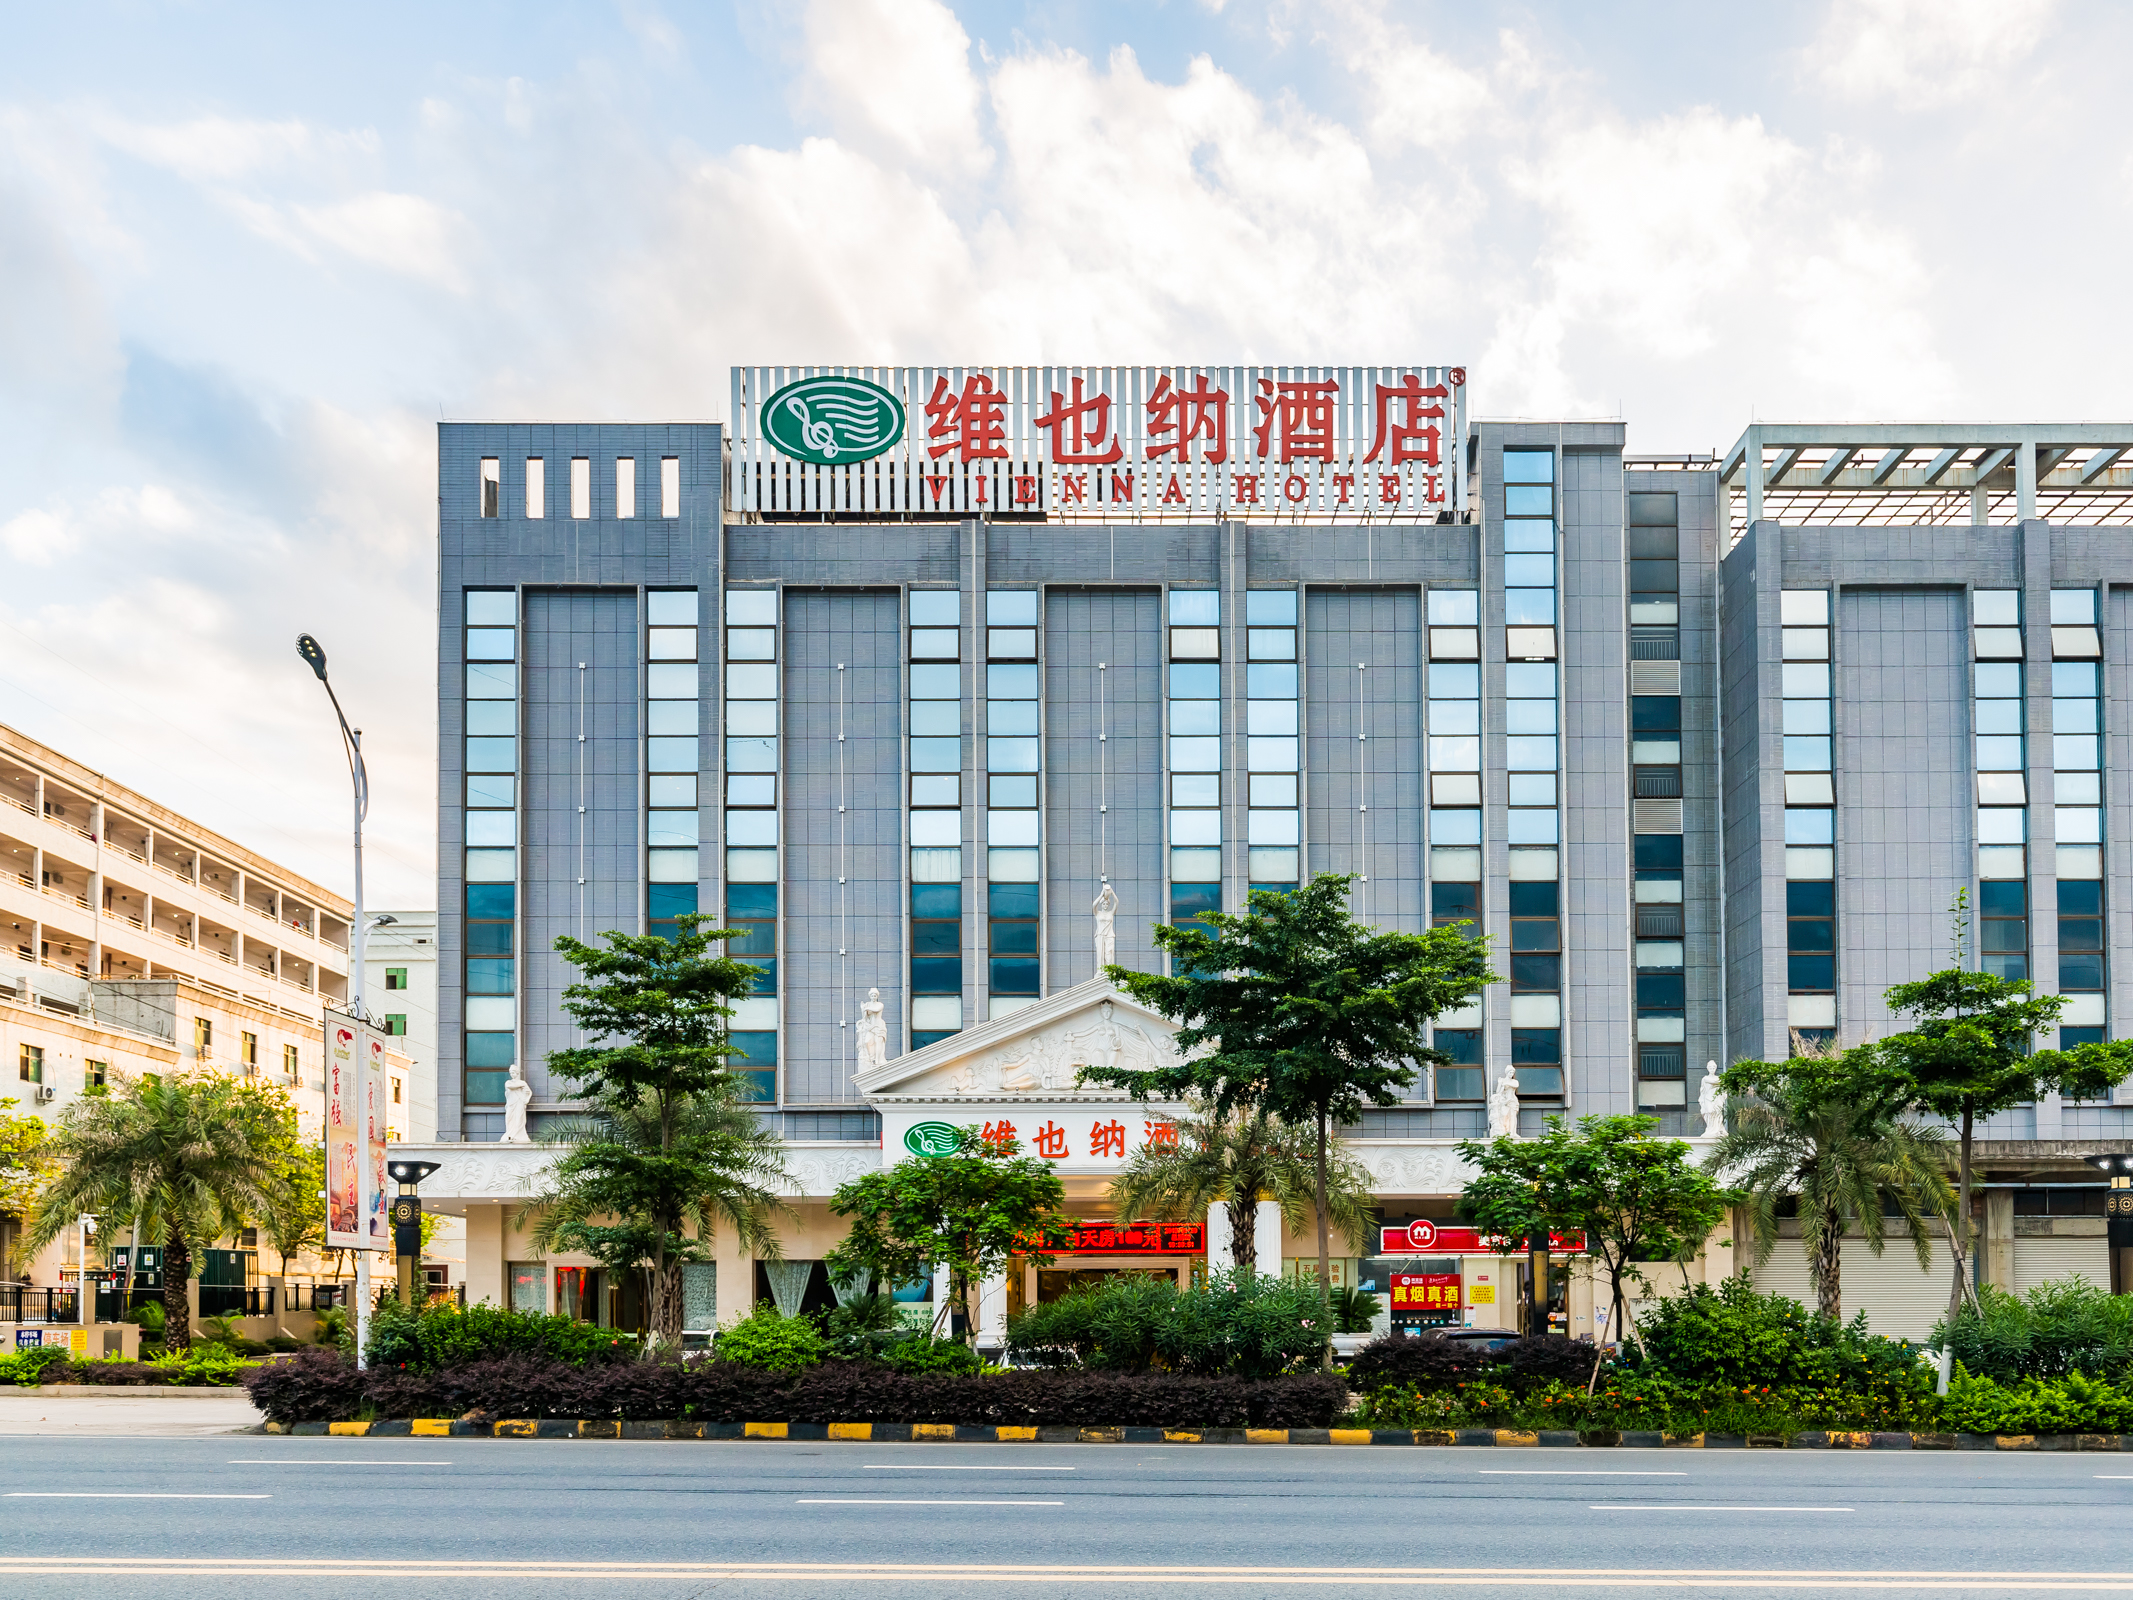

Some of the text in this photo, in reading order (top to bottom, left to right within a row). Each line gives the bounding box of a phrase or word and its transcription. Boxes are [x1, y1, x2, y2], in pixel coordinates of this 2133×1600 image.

[924, 374, 1449, 467] 维也纳酒店
[926, 475, 1447, 503] VIENNA HOTEL
[1393, 1285, 1459, 1303] 真烟真酒
[43, 1331, 69, 1346] 停车场
